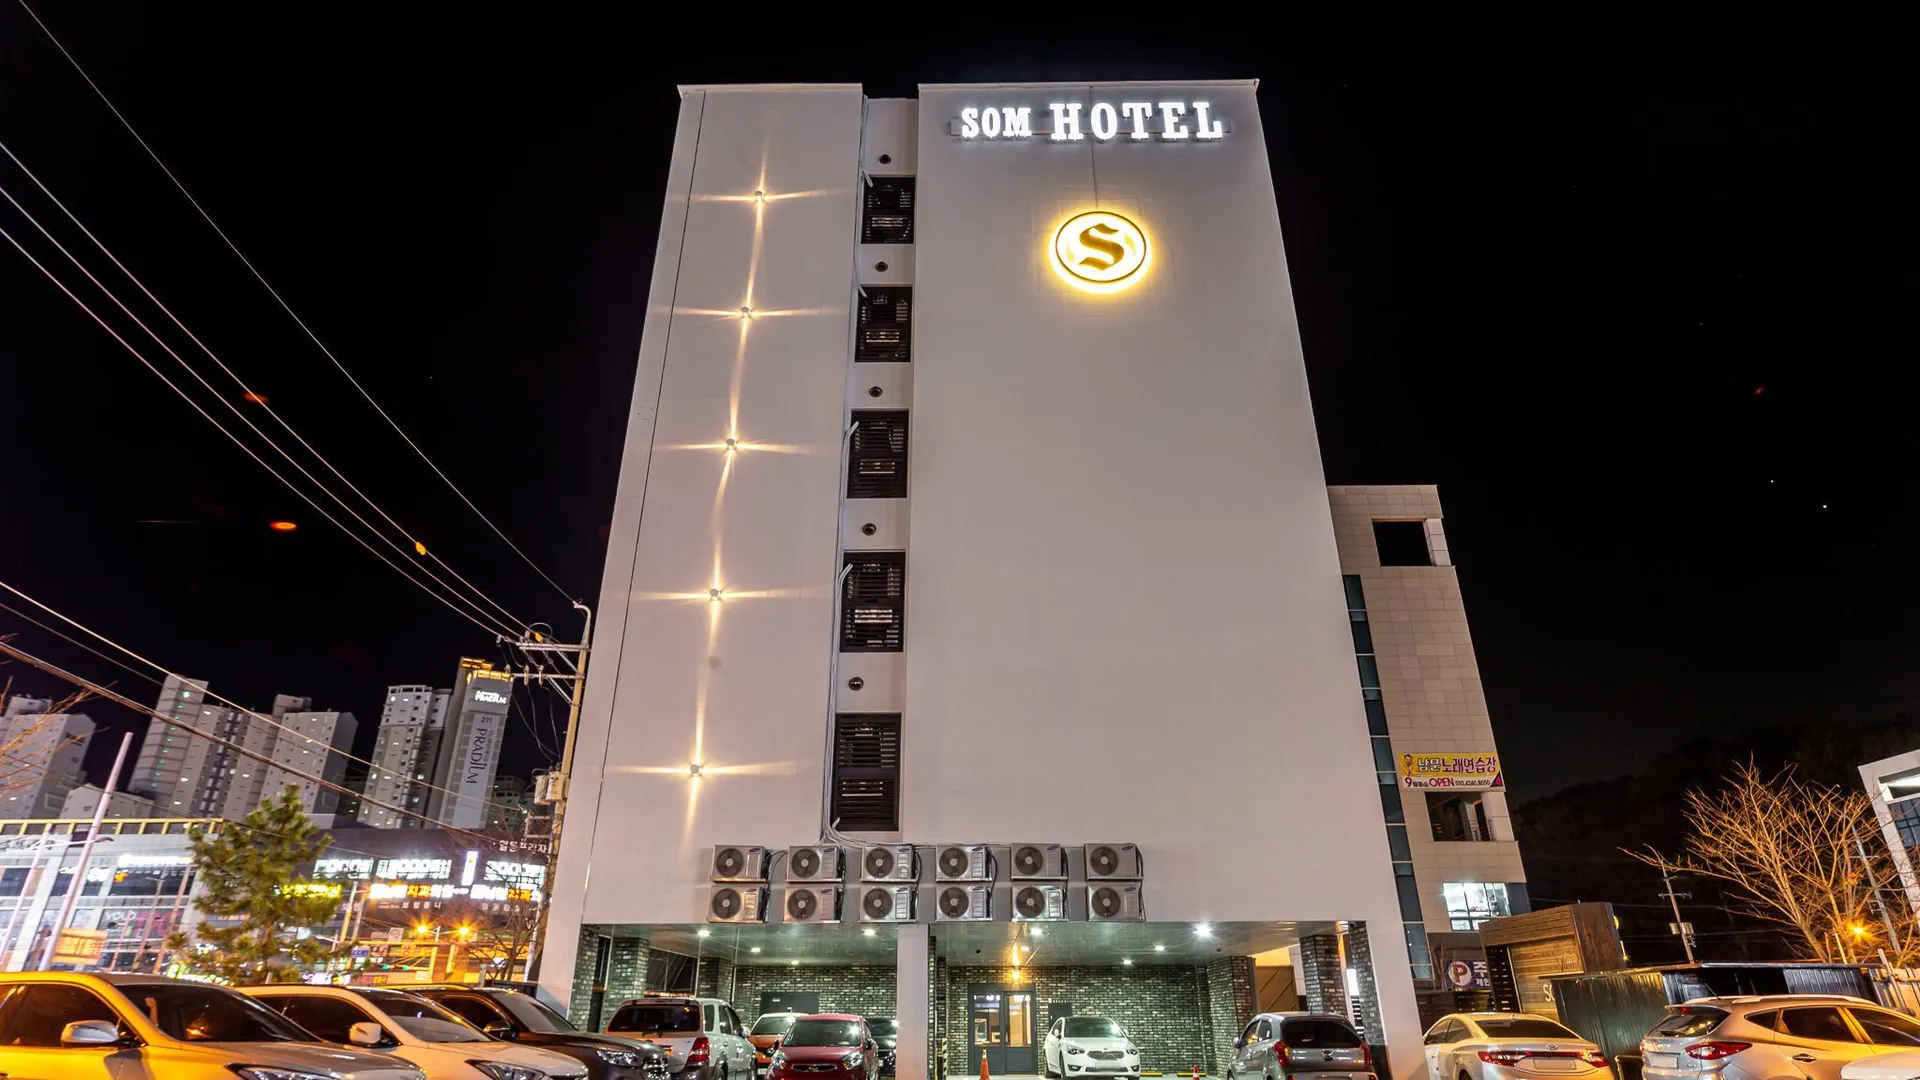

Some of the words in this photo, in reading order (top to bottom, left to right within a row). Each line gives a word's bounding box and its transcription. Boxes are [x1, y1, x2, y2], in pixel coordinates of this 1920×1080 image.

[961, 107, 1032, 138] SOM
[1050, 102, 1223, 140] HOTEL
[1078, 222, 1125, 271] S
[481, 716, 493, 724] 211
[1429, 777, 1455, 787] OPEN
[1452, 963, 1468, 984] P
